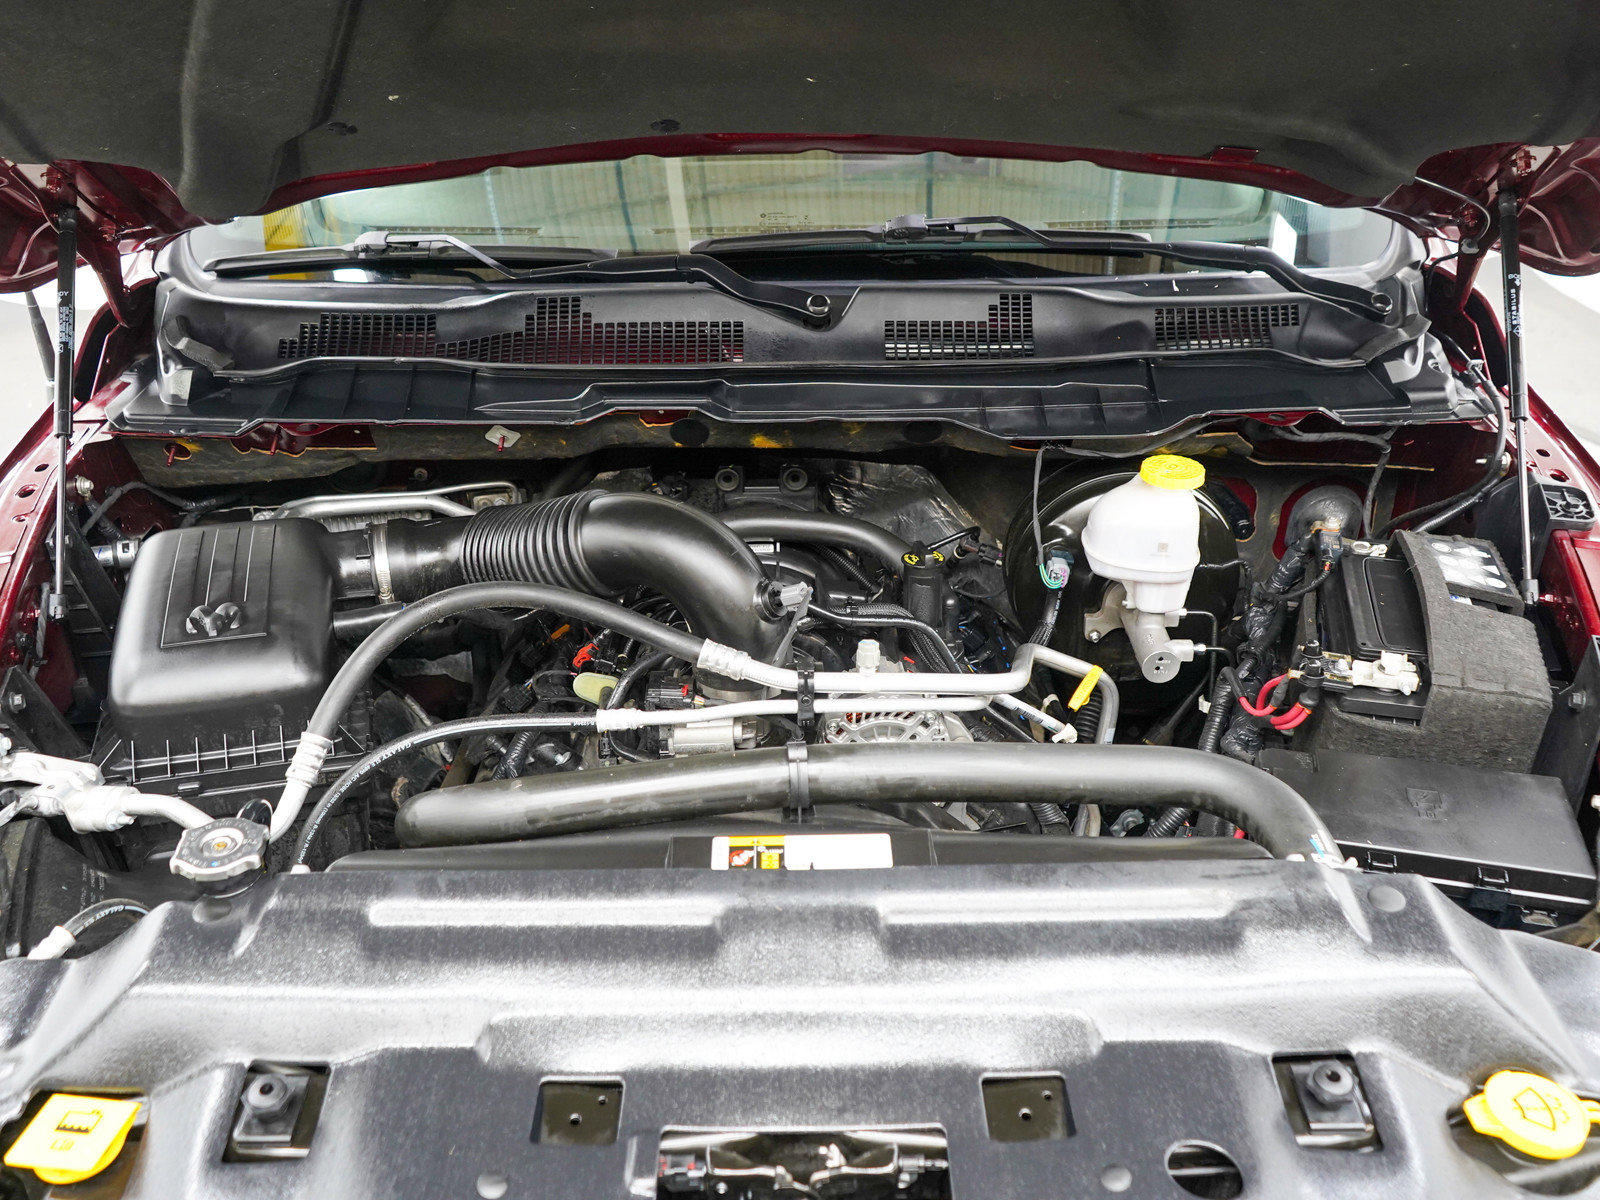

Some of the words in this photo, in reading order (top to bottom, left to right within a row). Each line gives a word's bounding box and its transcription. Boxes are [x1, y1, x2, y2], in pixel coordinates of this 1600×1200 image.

[382, 742, 412, 761] GALAXY
[340, 781, 353, 793] HOSE
[96, 905, 124, 921] GALAXY
